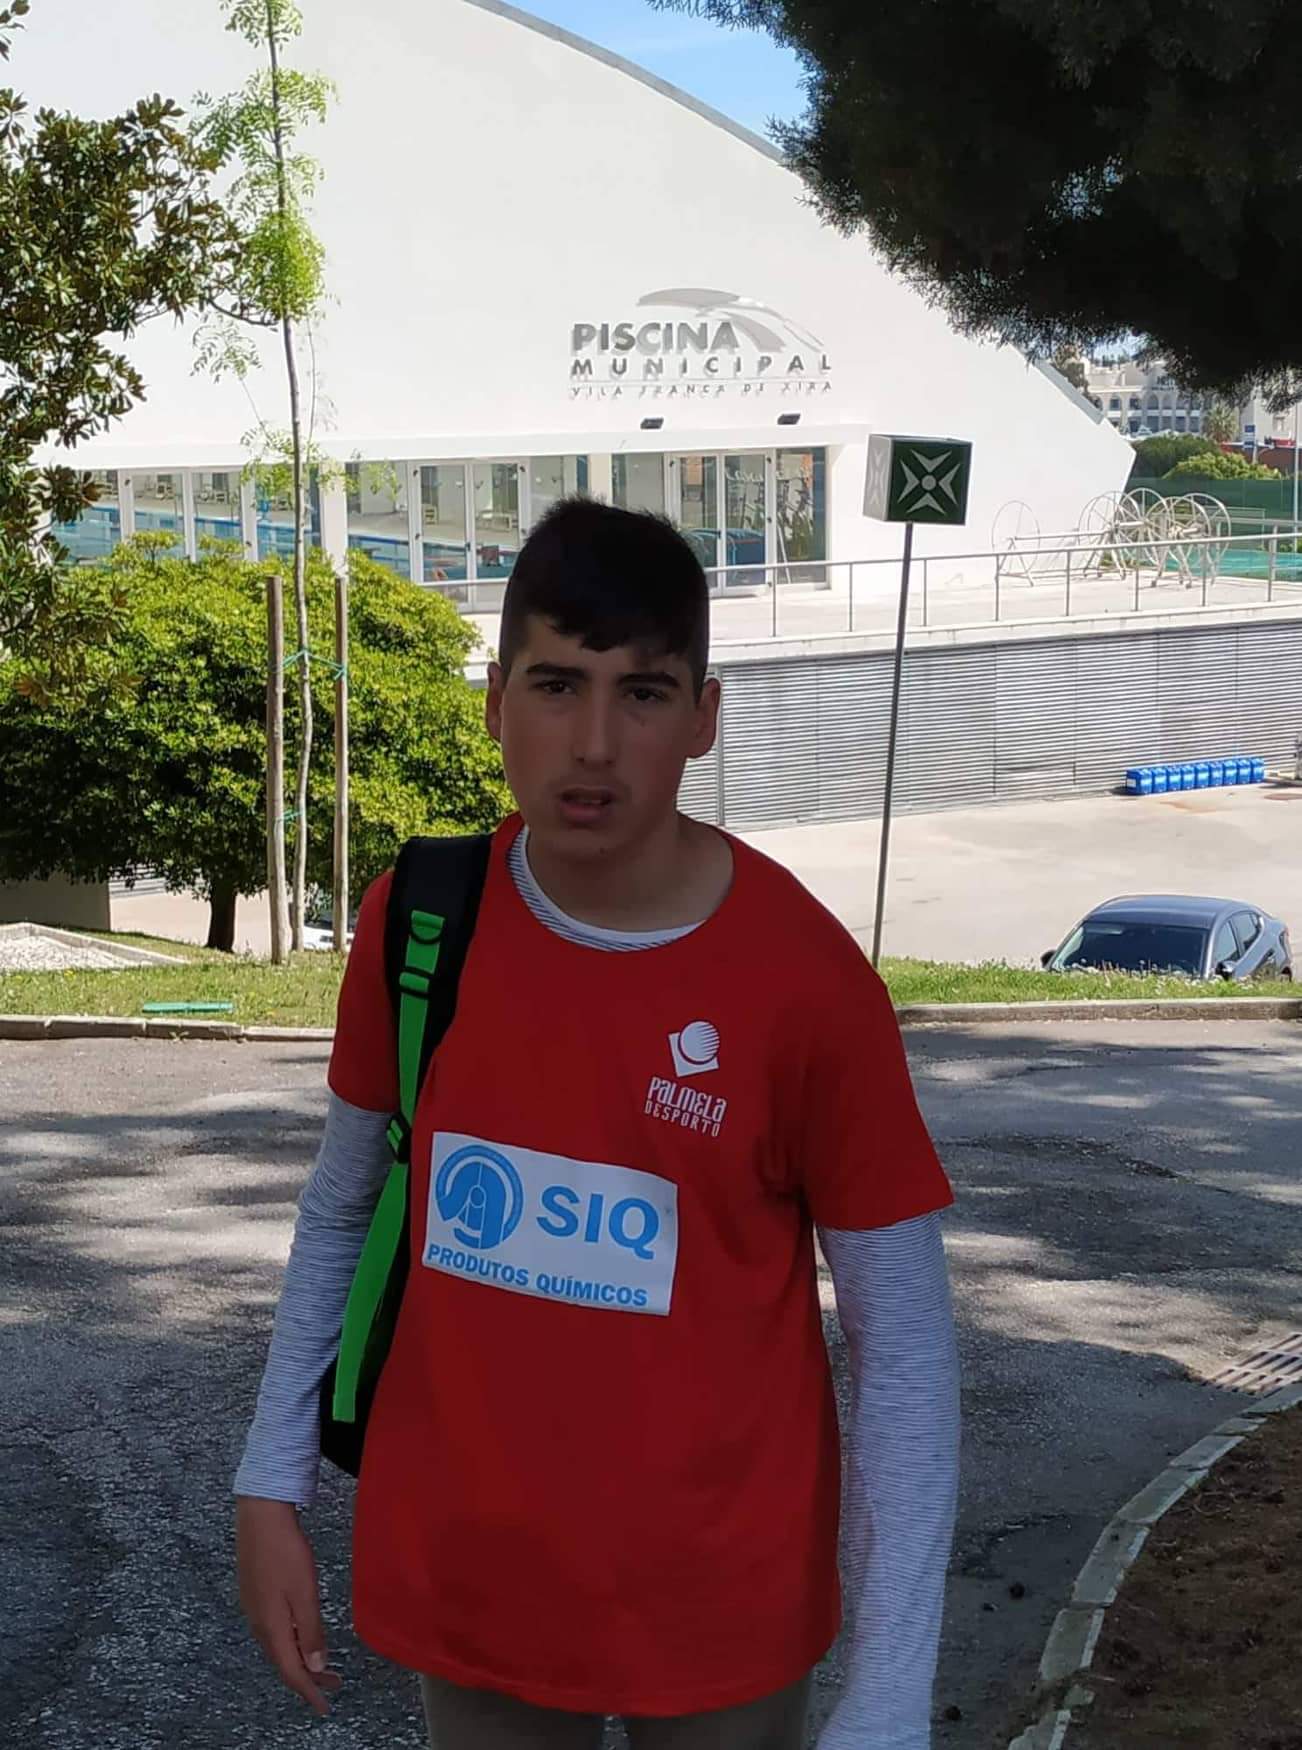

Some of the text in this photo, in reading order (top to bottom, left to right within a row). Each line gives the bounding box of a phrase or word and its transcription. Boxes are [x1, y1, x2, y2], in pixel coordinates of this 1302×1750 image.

[571, 321, 740, 352] PISCINA
[570, 354, 832, 376] MUNICIPAL
[572, 385, 623, 397] VILA
[644, 1100, 721, 1137] DESPORTO
[536, 1185, 659, 1260] SIQ
[427, 1243, 648, 1307] PRODUTOS QUÍMICOS
